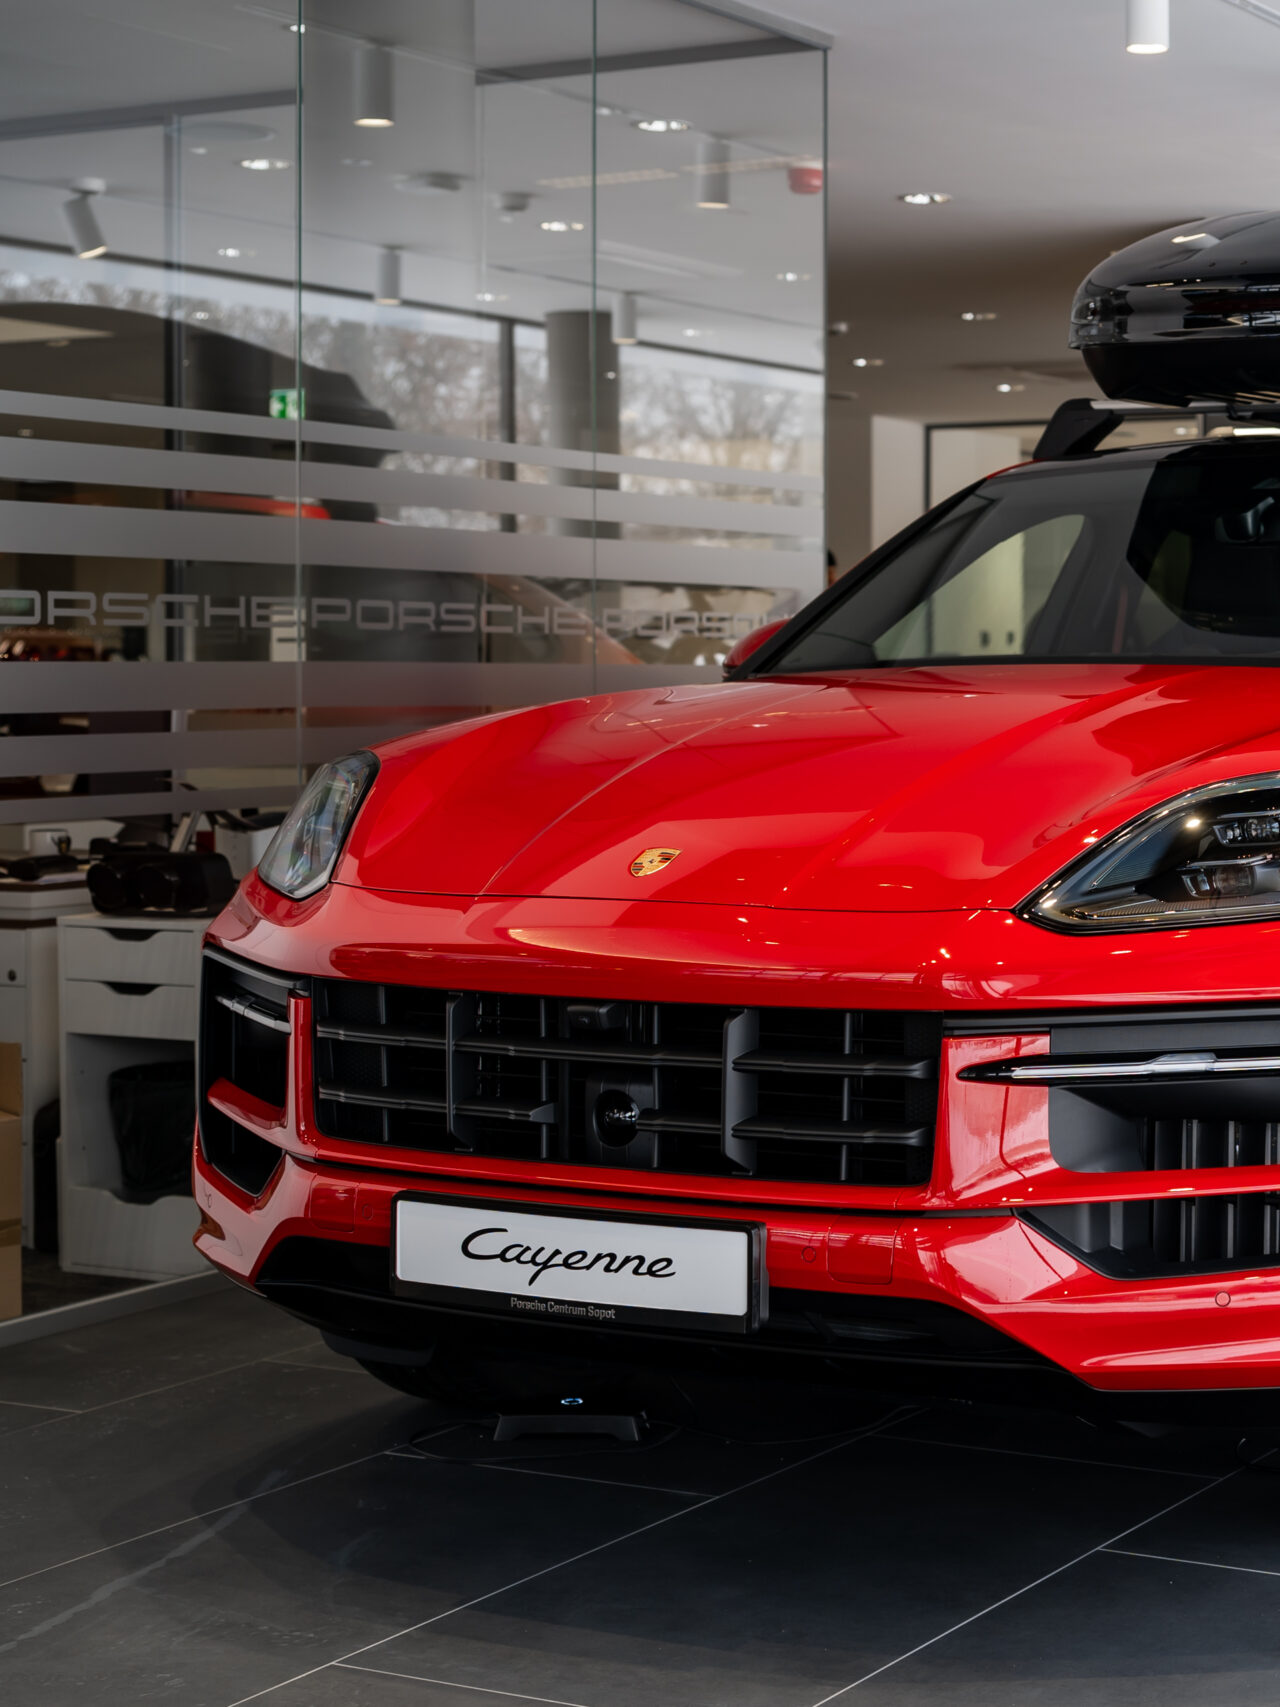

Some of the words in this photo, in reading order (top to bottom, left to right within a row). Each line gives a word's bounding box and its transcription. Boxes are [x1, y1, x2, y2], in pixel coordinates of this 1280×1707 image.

[311, 597, 587, 635] PORSCHE
[460, 1227, 676, 1286] Cayenne
[510, 1297, 546, 1311] Porsche
[547, 1301, 586, 1316] Centrum
[587, 1305, 616, 1320] Sopot
